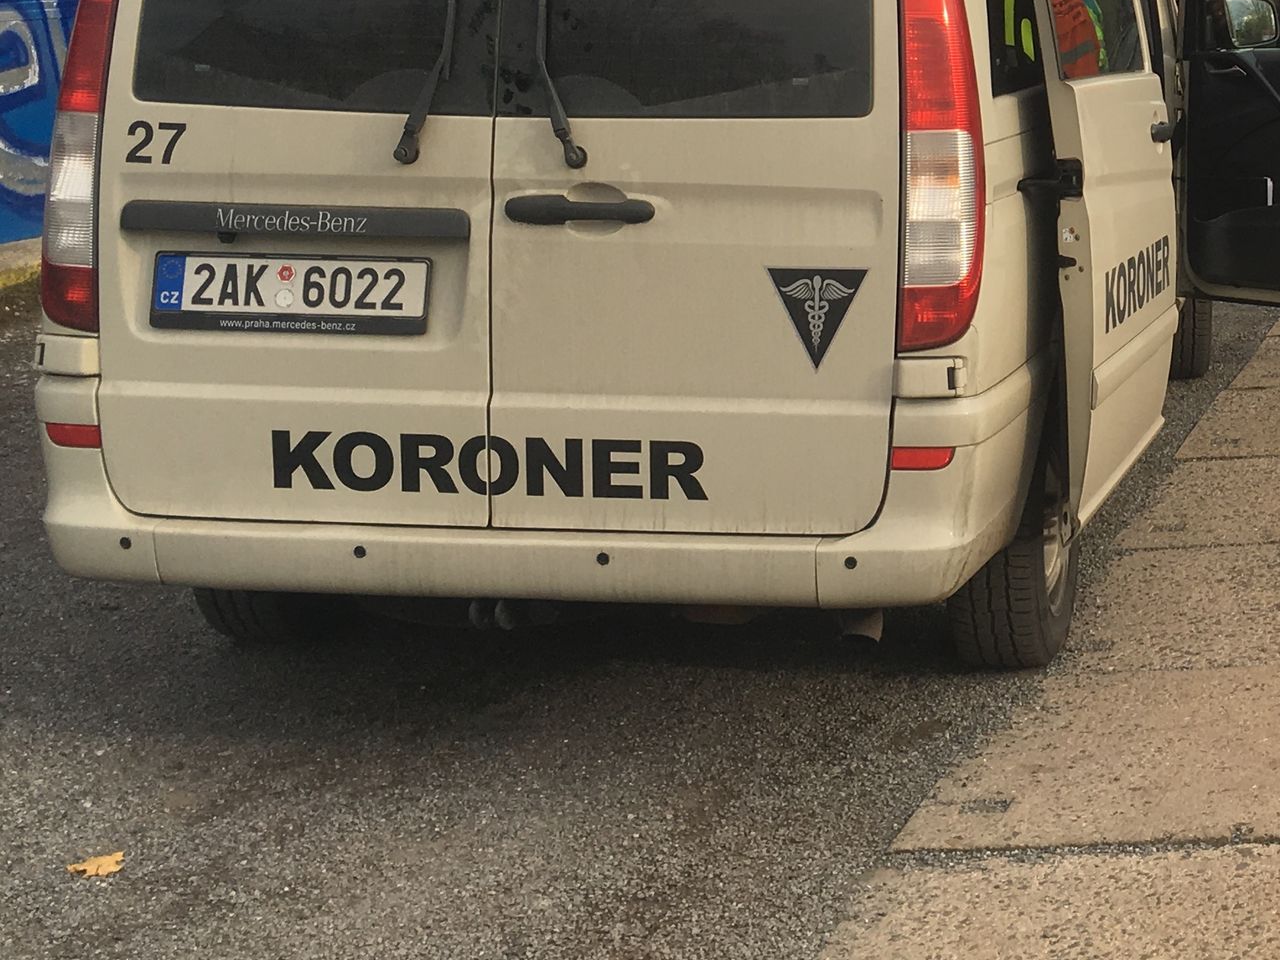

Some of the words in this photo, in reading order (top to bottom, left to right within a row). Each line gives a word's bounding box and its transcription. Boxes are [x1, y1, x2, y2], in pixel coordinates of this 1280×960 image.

[125, 120, 187, 165] 27
[216, 208, 368, 233] Mercedes-Benz
[160, 291, 179, 304] CZ
[191, 263, 269, 307] 2AK
[302, 266, 406, 310] 6022
[1105, 235, 1170, 334] KORONER
[219, 318, 357, 331] www.praha.mercedes-benz.cz
[271, 430, 709, 500] KORONER
